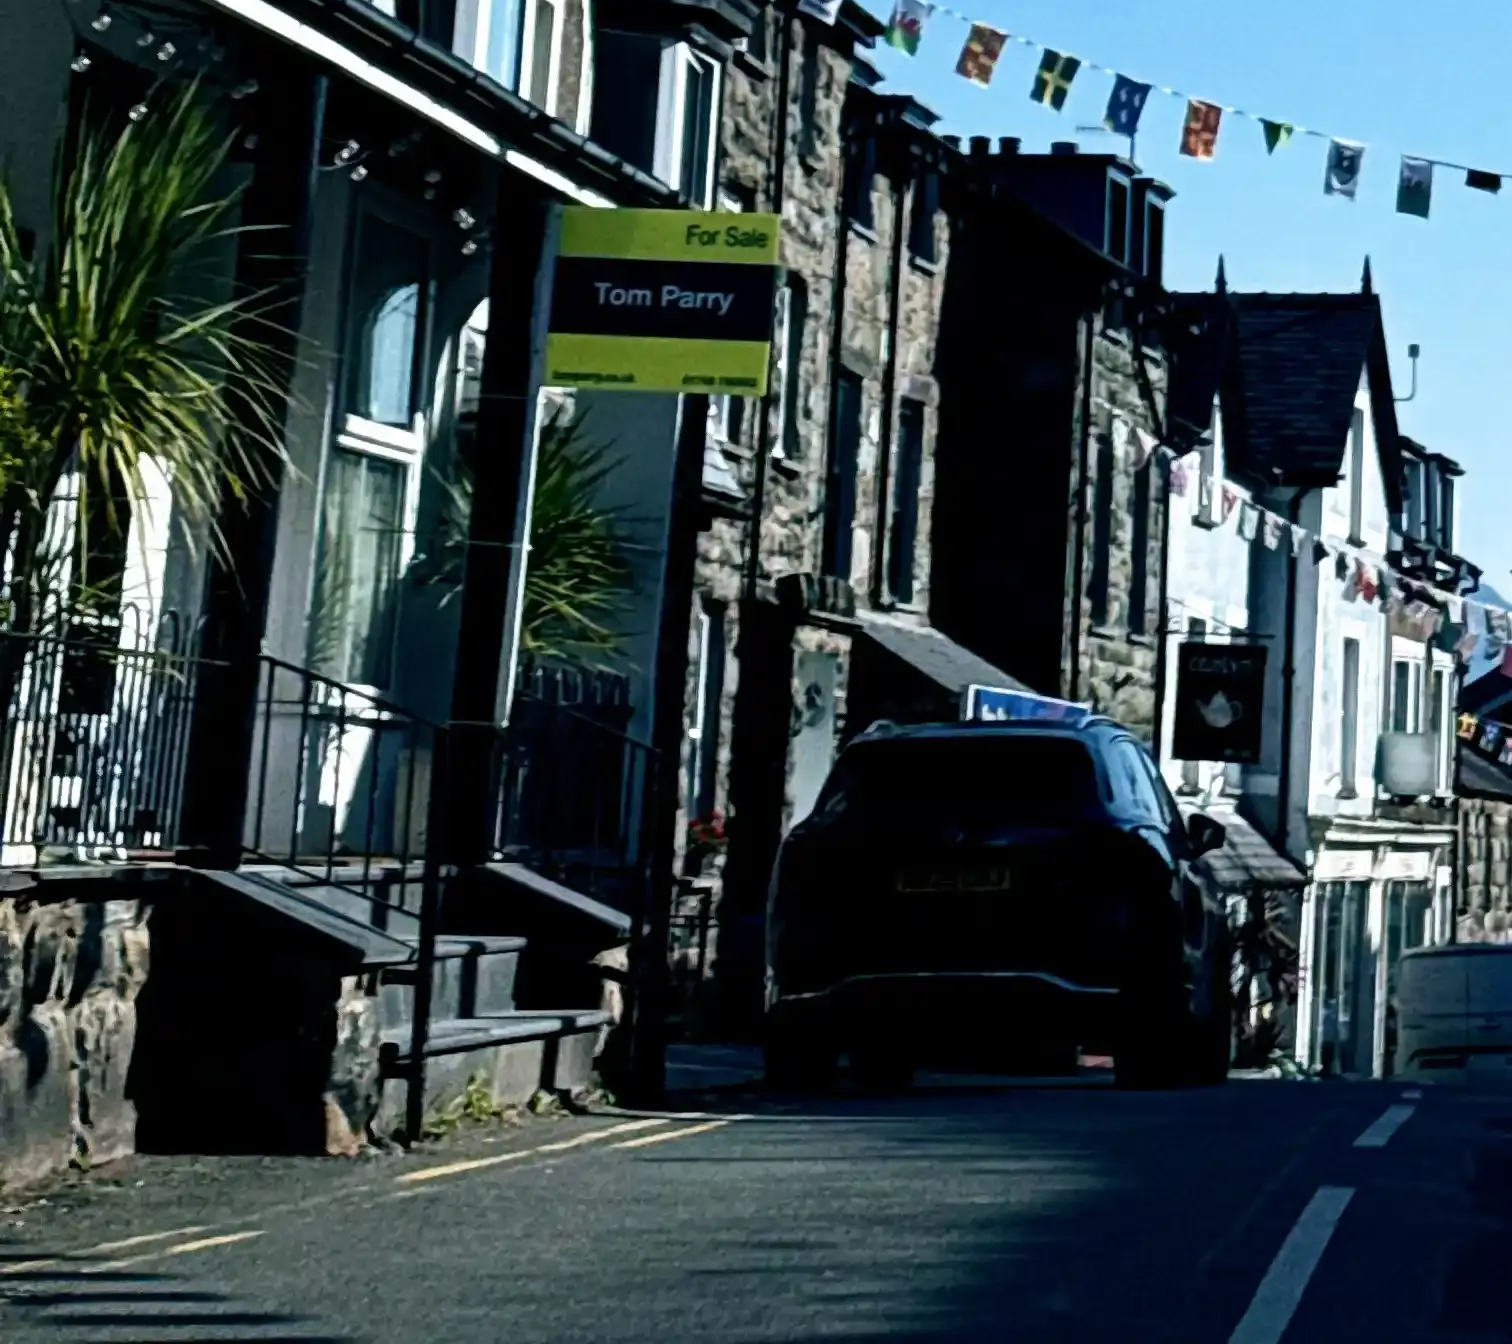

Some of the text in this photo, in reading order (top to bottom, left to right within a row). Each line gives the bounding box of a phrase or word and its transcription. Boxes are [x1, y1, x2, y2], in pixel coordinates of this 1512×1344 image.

[685, 224, 769, 248] For Sale
[594, 282, 734, 315] Tom Parry
